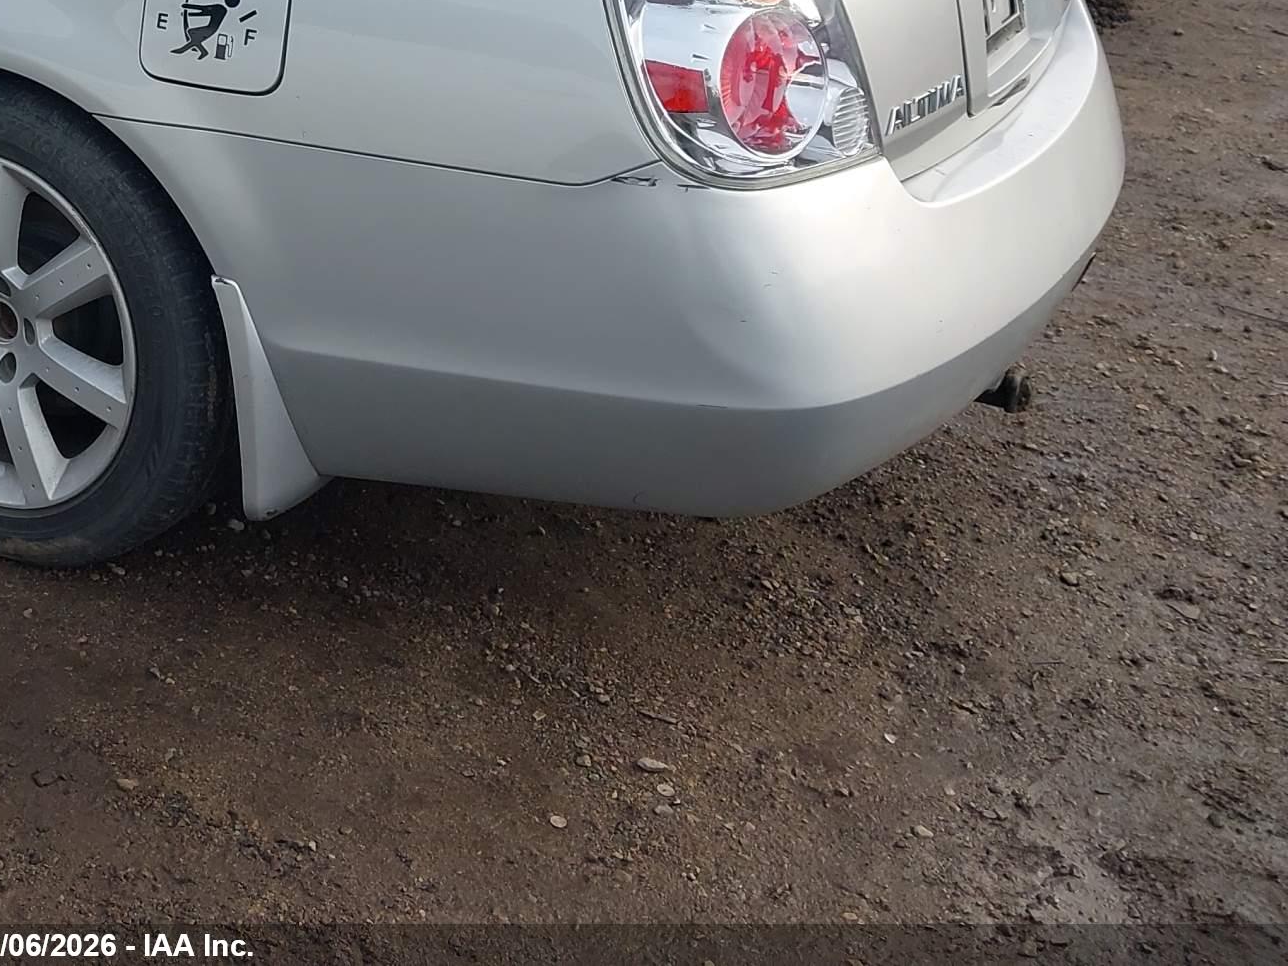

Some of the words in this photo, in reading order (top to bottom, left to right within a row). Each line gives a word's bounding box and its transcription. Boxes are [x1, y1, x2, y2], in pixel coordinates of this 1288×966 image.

[156, 13, 169, 30] E
[244, 29, 258, 46] F
[885, 74, 964, 136] ALTIMA
